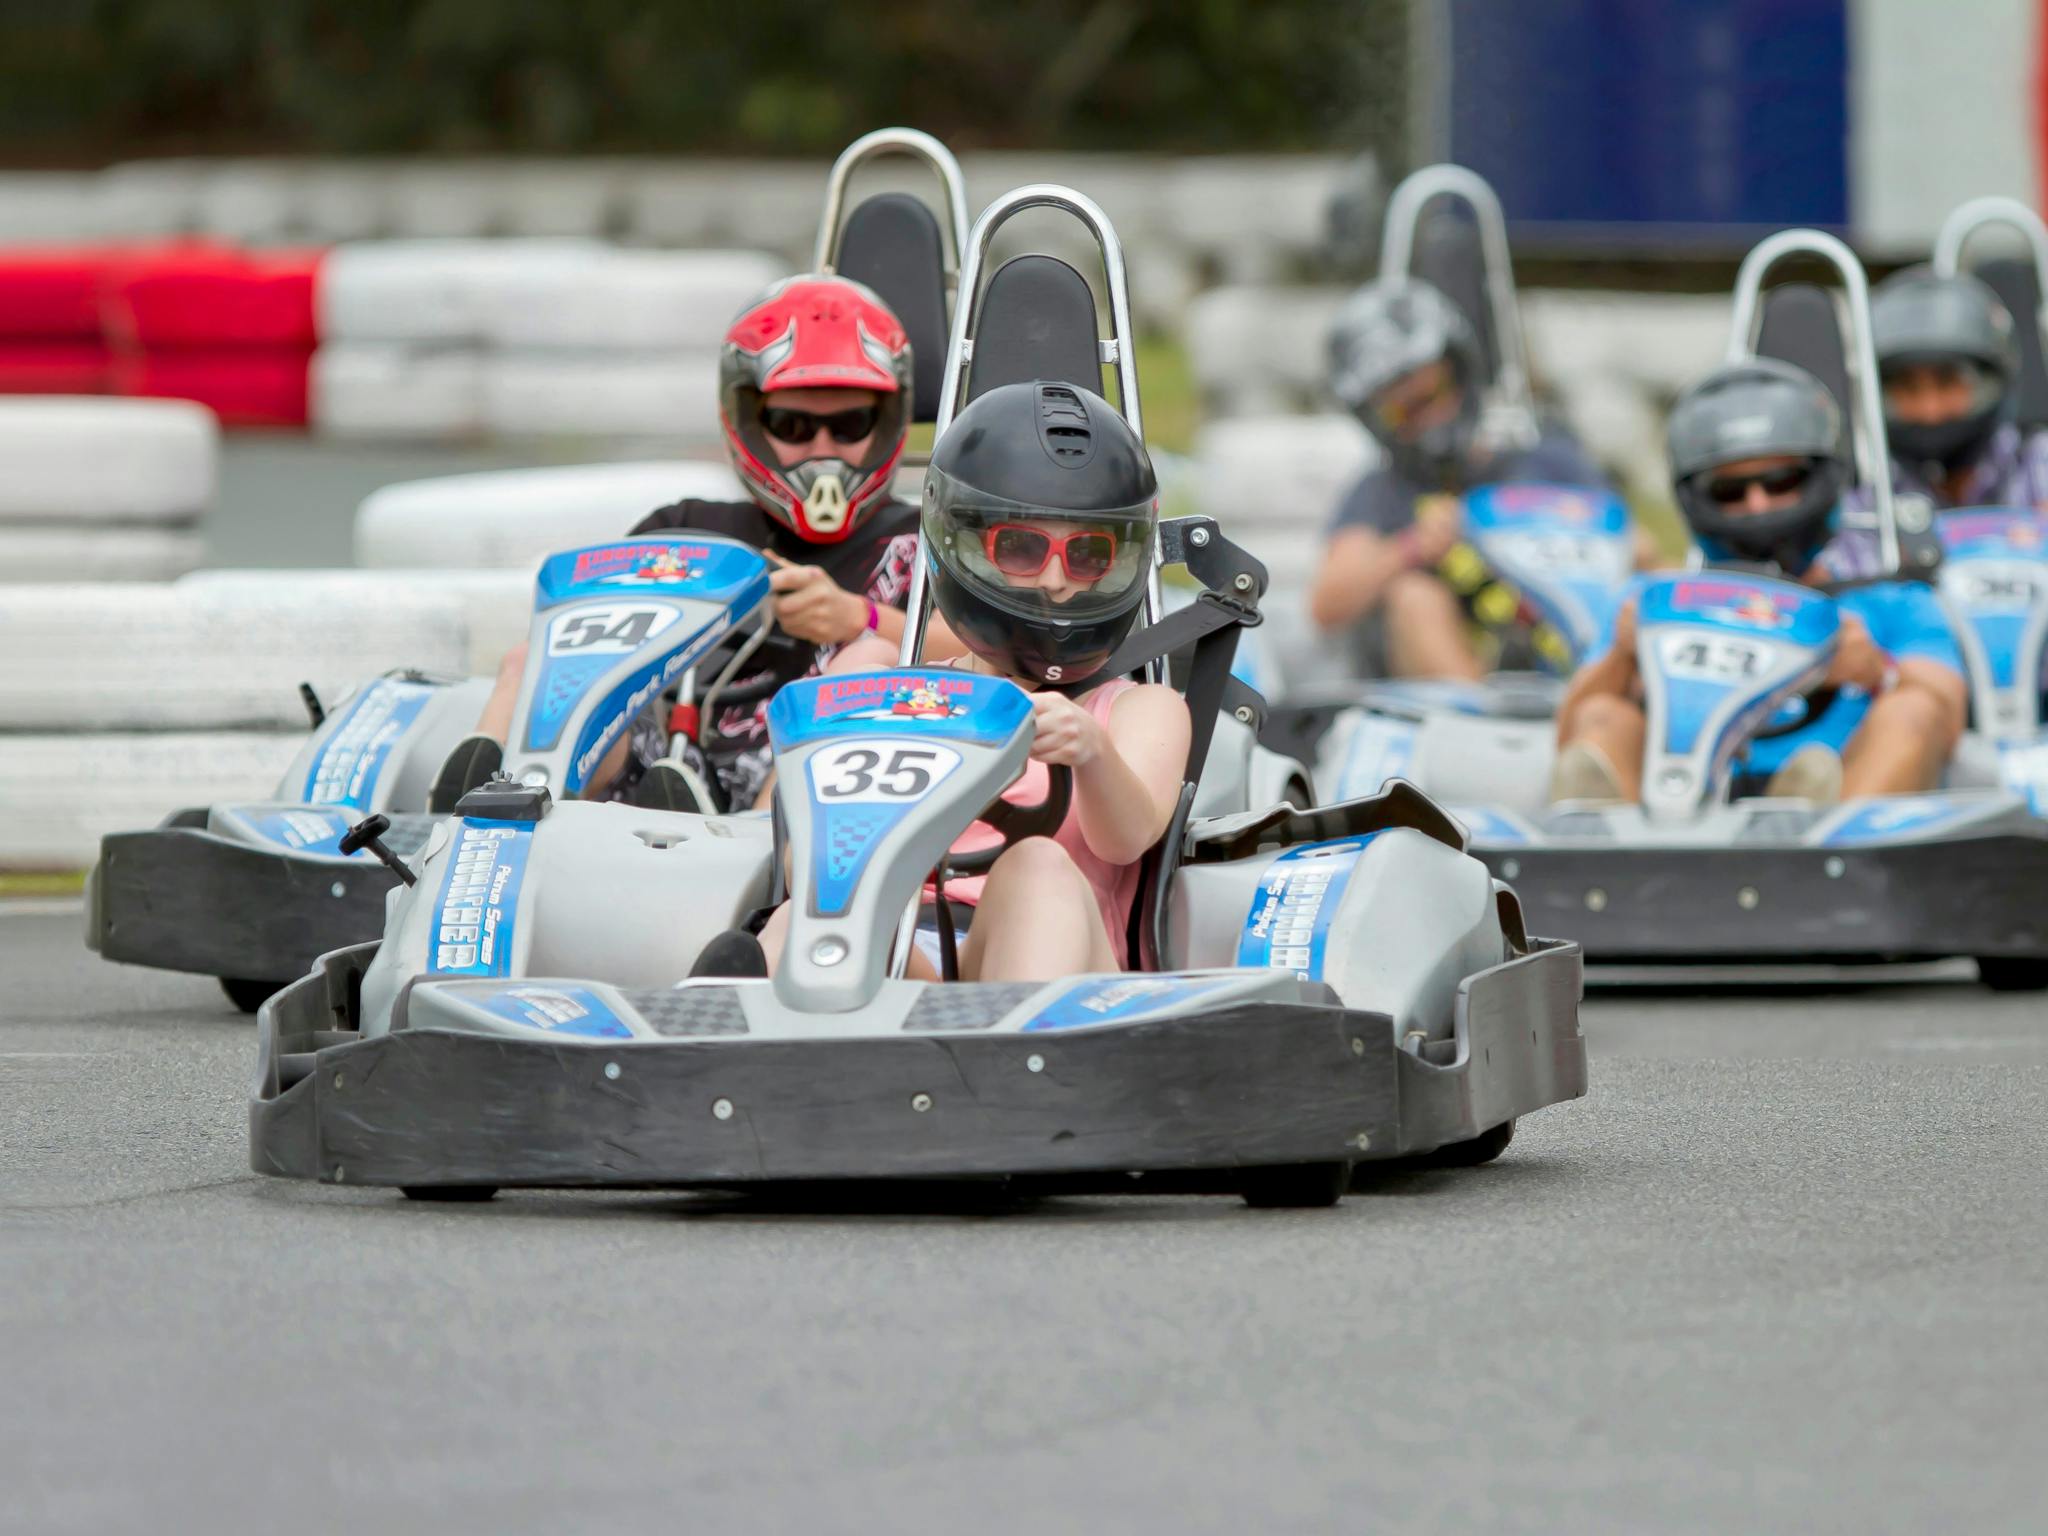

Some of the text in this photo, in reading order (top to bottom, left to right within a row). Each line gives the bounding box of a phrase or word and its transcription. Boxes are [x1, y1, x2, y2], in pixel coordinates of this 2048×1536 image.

[555, 611, 658, 649] 54
[1045, 665, 1063, 681] S
[822, 749, 939, 798] 35
